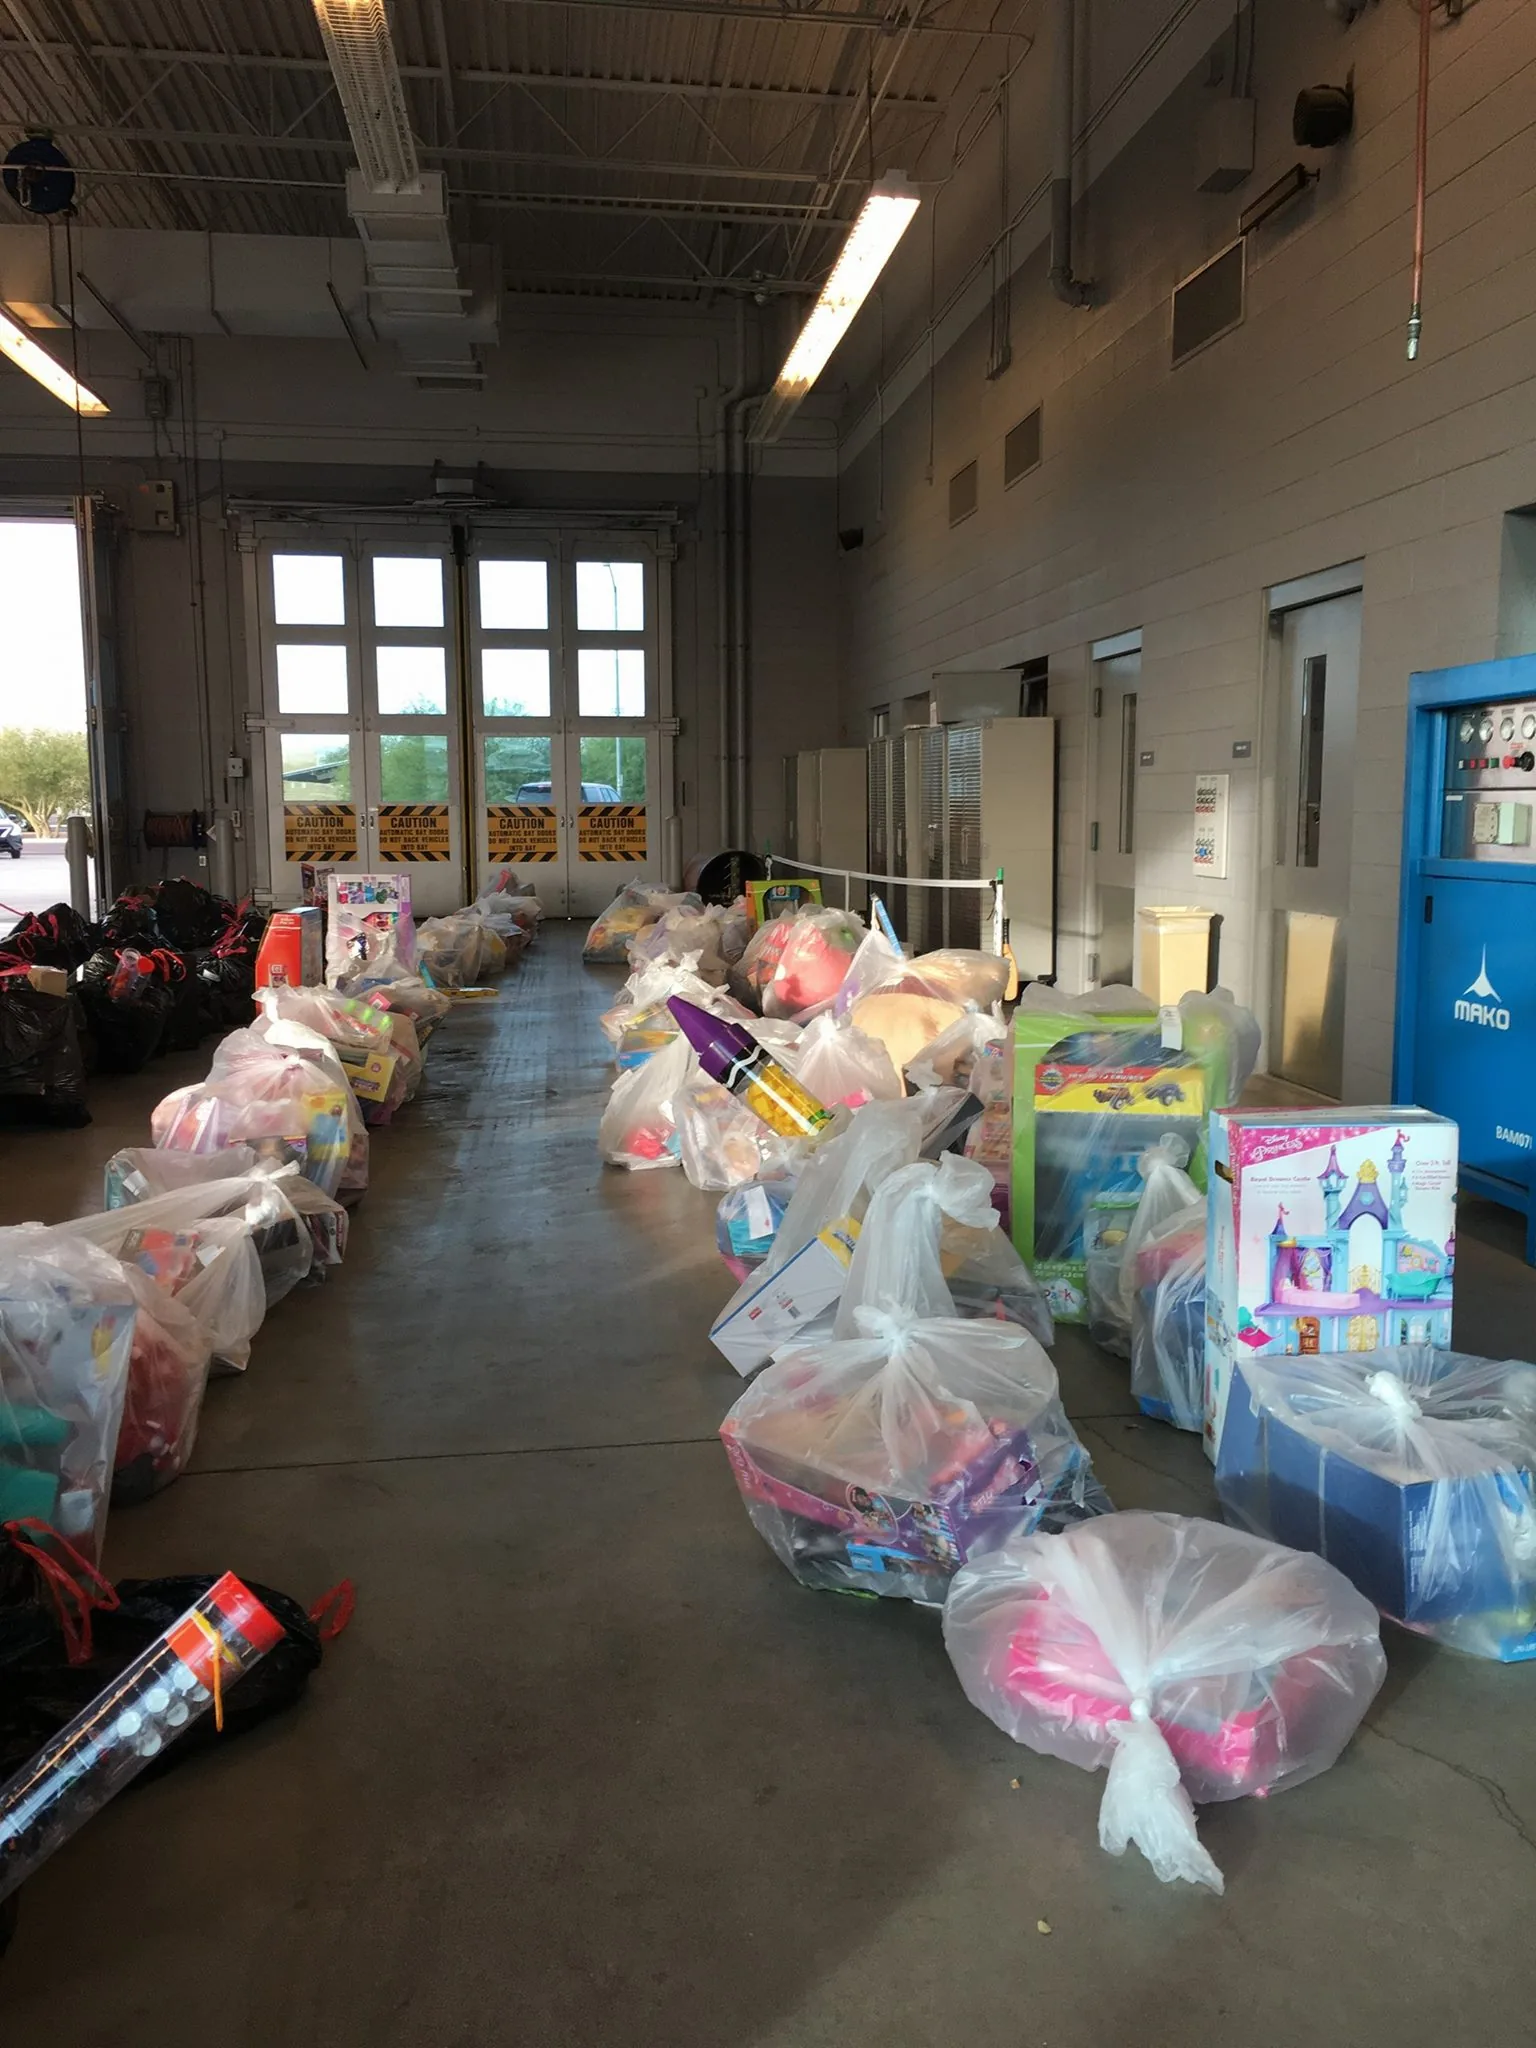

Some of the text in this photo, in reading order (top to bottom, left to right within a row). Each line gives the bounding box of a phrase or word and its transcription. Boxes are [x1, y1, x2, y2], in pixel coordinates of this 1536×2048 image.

[297, 817, 344, 828] CAUTION
[391, 817, 437, 828] CAUTION
[500, 818, 544, 829] CAUTION
[590, 817, 634, 828] CAUTION
[1454, 999, 1511, 1031] MAKO
